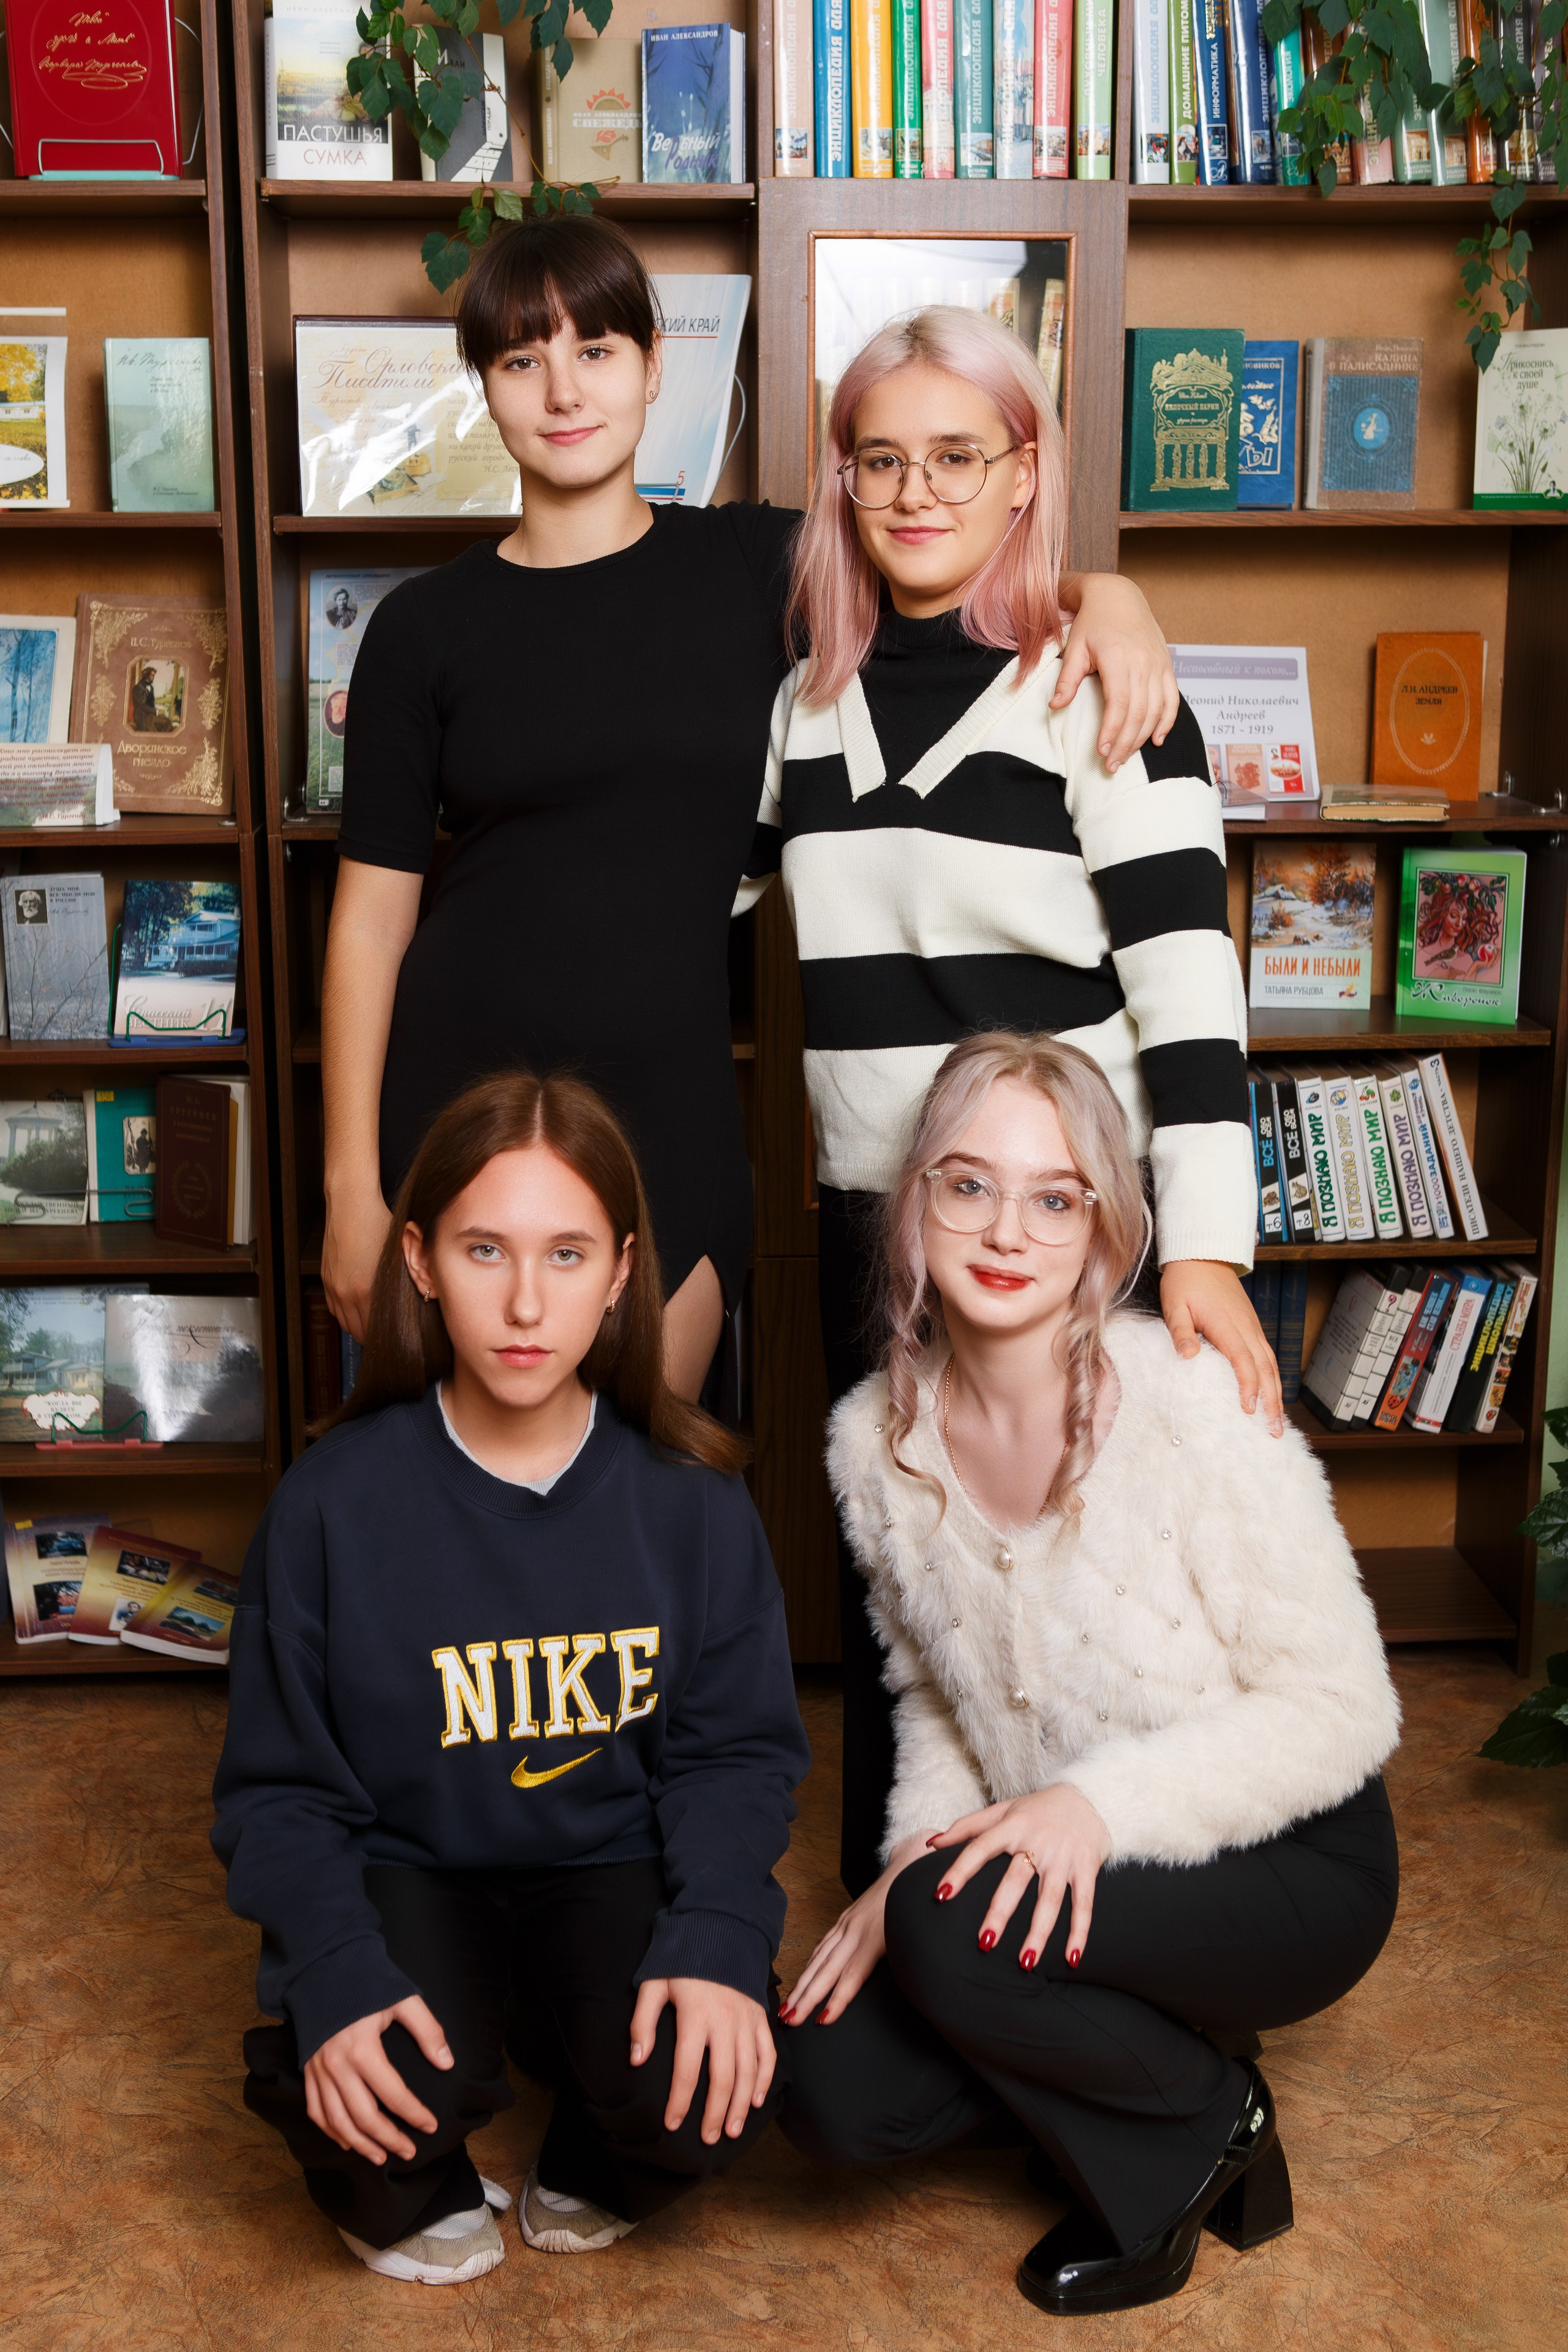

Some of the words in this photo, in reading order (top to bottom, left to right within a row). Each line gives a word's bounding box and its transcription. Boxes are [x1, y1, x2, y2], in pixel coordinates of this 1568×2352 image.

[650, 33, 669, 42] ИВАН
[671, 30, 718, 40] АЛЕКСАНДРОВ
[1180, 0, 1189, 45] ПИТОМ
[1097, 8, 1107, 78] ЧЕЛОВЕКА
[787, 13, 797, 119] ЭНЦИКЛОПЕДИЯ
[904, 15, 914, 120] ЭНЦИКЛОПЕДИЯ
[971, 19, 982, 124] ЭНЦИКЛОПЕДИЯ
[1047, 12, 1058, 118] ЭНЦИКЛОПЕДИЯ
[1150, 20, 1160, 124] ЭНЦИКЛОПЕДИЯ
[1181, 45, 1192, 119] ДОМАШНИЕ
[1210, 42, 1221, 119] ИНФОРМАТИКА
[1258, 18, 1270, 123] ЭНЦИКЛОПЕДИЯ
[830, 35, 842, 162] ЭНЦИКЛОПЕДИЯ
[937, 37, 948, 164] ЭНЦИКЛОПЕДИЯ
[284, 124, 383, 143] ПАСТУШЬЯ
[303, 149, 367, 166] СУМКА
[657, 315, 686, 333] КИЙ
[688, 315, 720, 333] КРАЙ
[311, 360, 436, 390] Писатели
[364, 347, 469, 381] Орловски
[1374, 353, 1418, 363] КАЛИНА
[1501, 352, 1554, 372] Прикоснись
[1520, 369, 1544, 379] своей
[1516, 380, 1539, 391] душе
[448, 454, 478, 464] русский
[676, 470, 686, 486] 5
[1244, 666, 1251, 674] к
[1183, 695, 1224, 706] Леонид
[1227, 695, 1300, 706] Николаевич
[1419, 685, 1458, 695] АНДРЕЕВ
[1210, 725, 1235, 735] 1871
[1249, 725, 1274, 735] 1919
[1216, 710, 1266, 722] Андреев
[116, 739, 187, 757] Дворянское
[1264, 955, 1298, 976] БЫЛИ
[1302, 957, 1309, 976] И
[1313, 957, 1361, 978] НЕБЫЛИ
[1264, 985, 1292, 995] ТАТЬЯНА
[1294, 986, 1324, 996] РУБЦОВА
[195, 997, 233, 1031] 11
[1430, 1057, 1440, 1068] 3
[1308, 1112, 1326, 1147] МИР
[1335, 1114, 1354, 1148] МИР
[1363, 1109, 1382, 1144] МИР
[1393, 1114, 1411, 1147] МИР
[1441, 1092, 1456, 1137] ДЕТСТВА
[1261, 1138, 1274, 1167] ВСЕ
[1287, 1130, 1301, 1159] ВСЕ
[1419, 1123, 1438, 1177] ЗАДАНИЙ
[1450, 1137, 1467, 1182] НАШЕГО
[1313, 1149, 1336, 1213] ПОЗНАЮ
[1340, 1150, 1363, 1214] ПОЗНАЮ
[1370, 1146, 1393, 1209] ПОЗНАЮ
[1401, 1149, 1425, 1214] ПОЗНАЮ
[1430, 1177, 1442, 1199] 1000
[1321, 1215, 1338, 1229] Я
[1348, 1213, 1365, 1229] Я
[1378, 1210, 1396, 1224] Я
[1412, 1212, 1428, 1227] Я
[1461, 1183, 1480, 1236] ПИСАТЕЛИ
[1449, 1317, 1468, 1351] СТРАНЫ
[1470, 1283, 1506, 1373] ЭНЦИКЛОПЕДИЯ
[1485, 1284, 1516, 1355] ШКОЛЬНИКУ
[432, 1626, 660, 1749] NIKE
